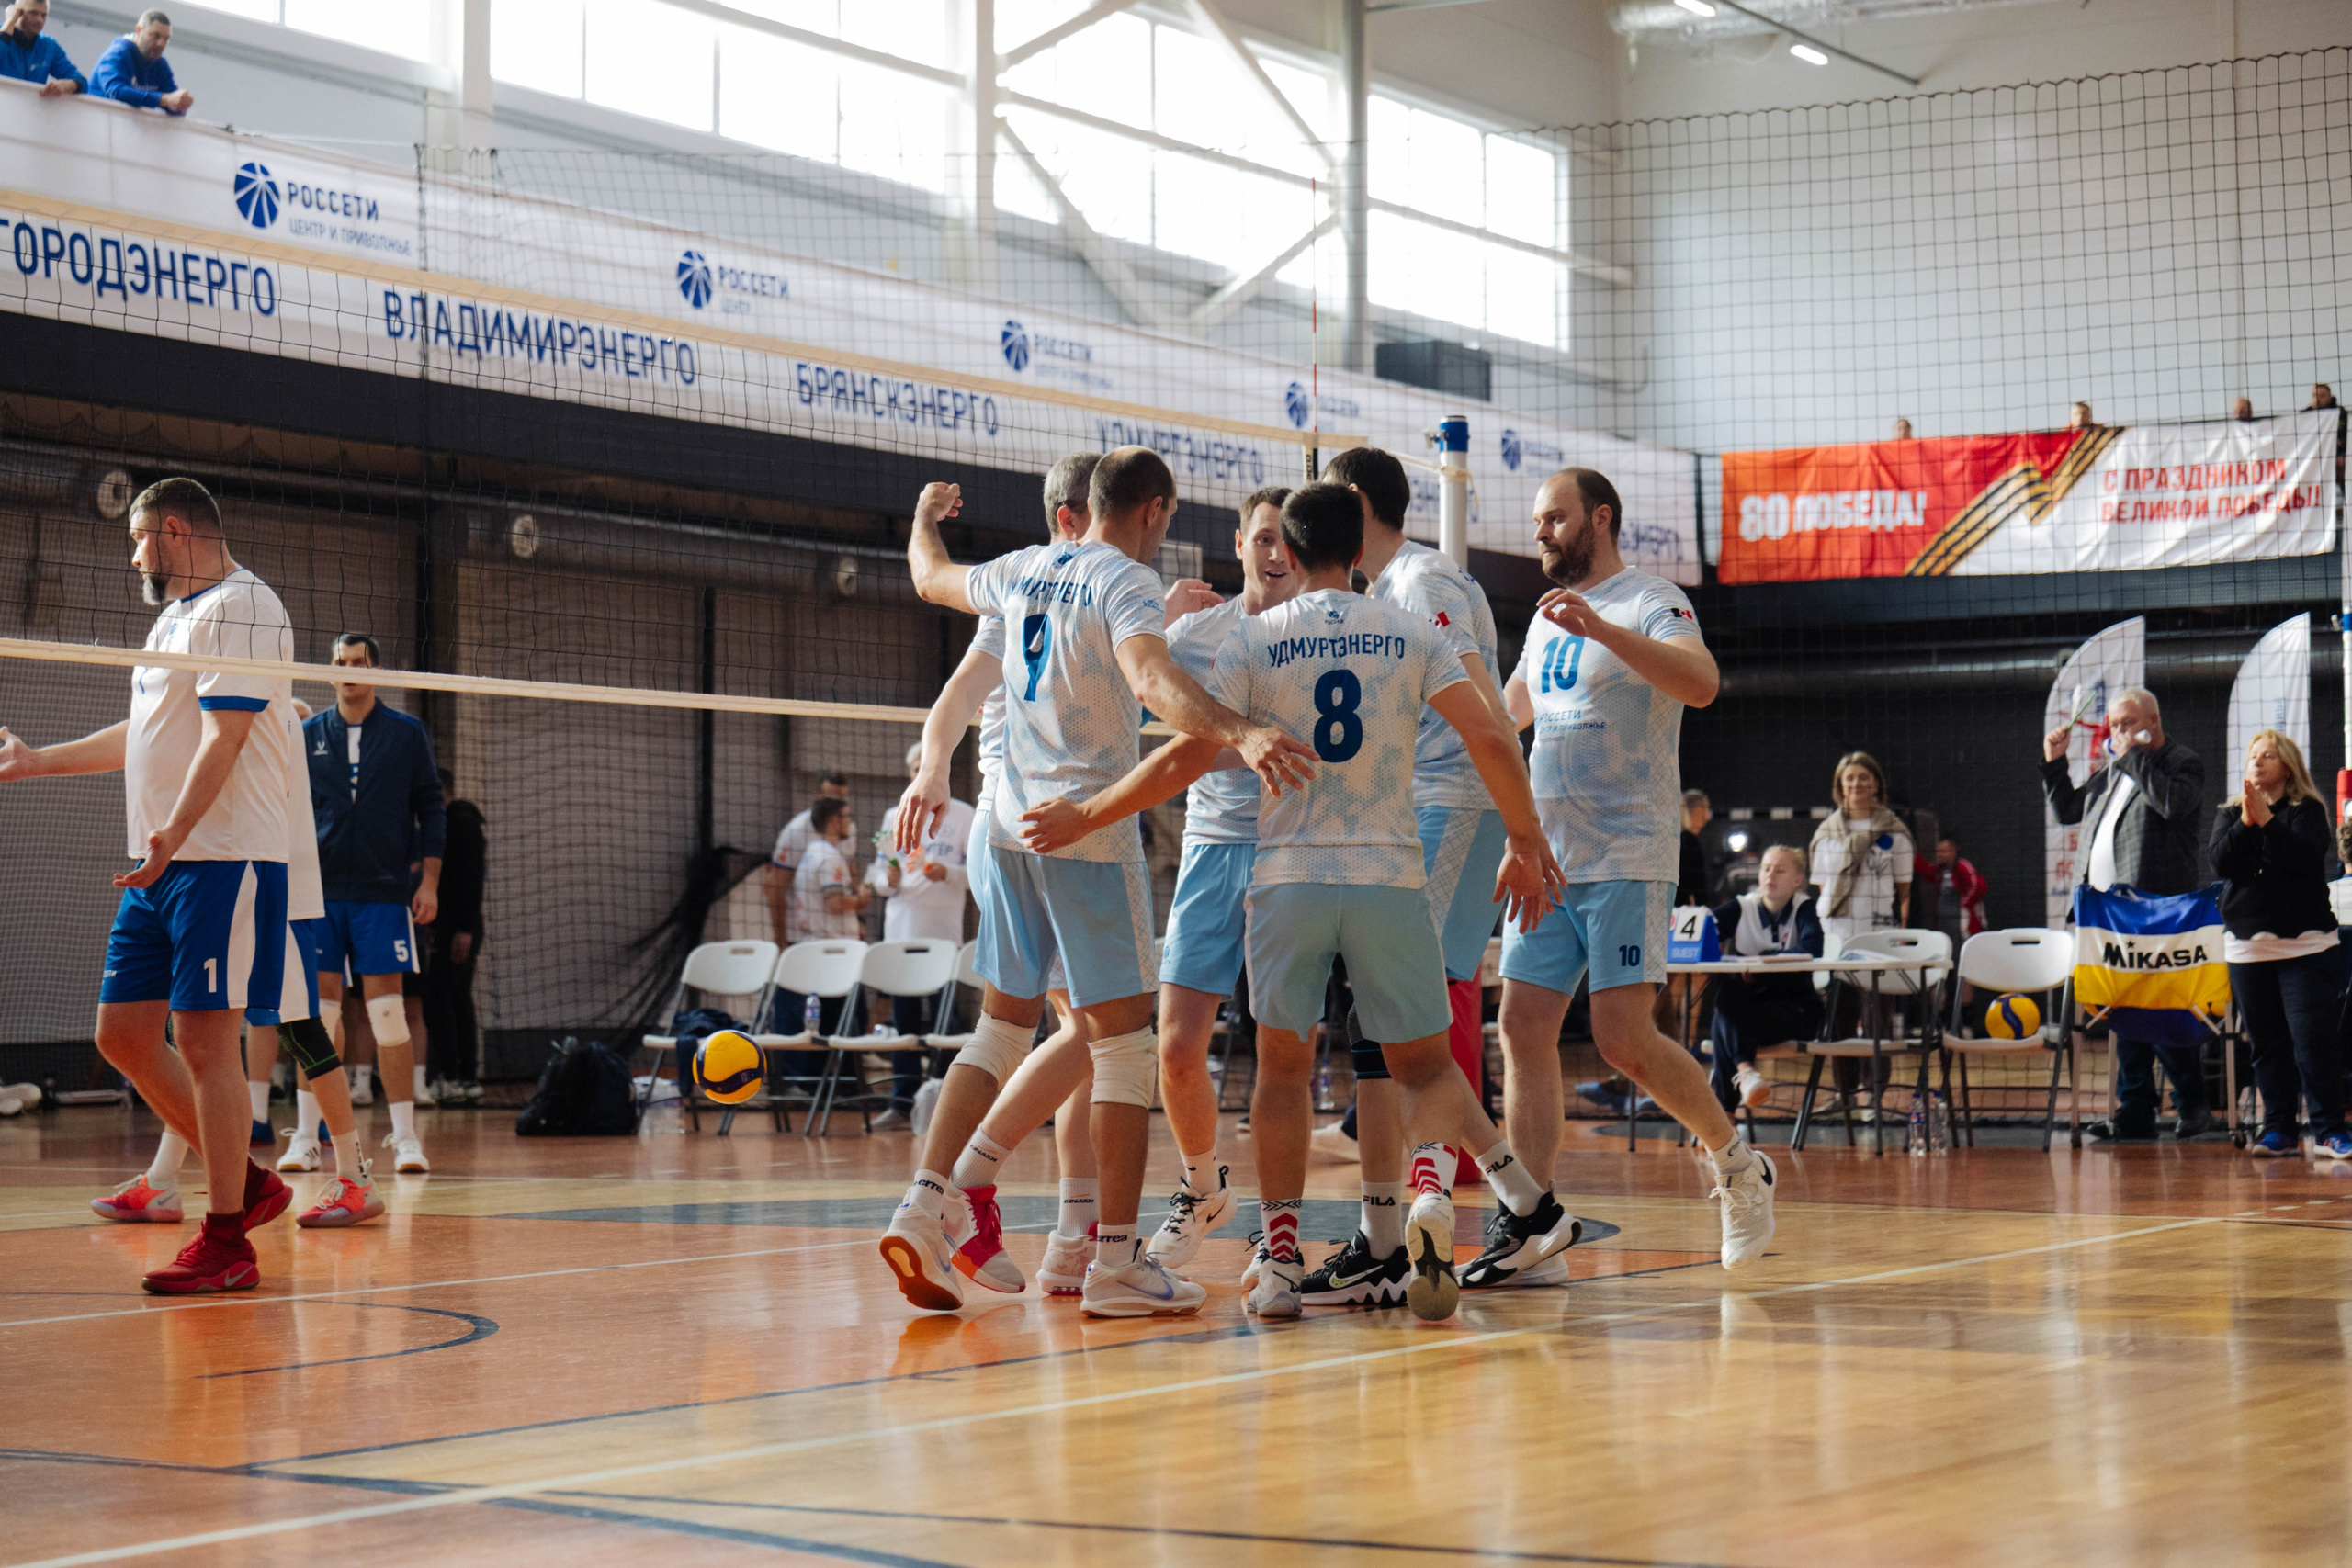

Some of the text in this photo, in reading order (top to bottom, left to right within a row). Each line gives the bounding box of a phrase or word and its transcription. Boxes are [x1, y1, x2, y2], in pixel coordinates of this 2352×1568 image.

[287, 181, 379, 222] РОССЕТИ
[288, 218, 412, 257] ЦЕНТР И ПРИВОЛЖЬЕ
[718, 265, 789, 301] РОССЕТИ
[384, 290, 695, 386] ВЛАДИМИРЭНЕРГО
[796, 363, 999, 436] БРЯНСКЭНЕРГО
[2104, 458, 2286, 492] С ПРАЗДНИКОМ
[1738, 492, 1790, 542] 80
[1794, 488, 1927, 533] ПОБЕДА!
[2101, 484, 2321, 524] ВЕЛИКОЙ ПОБЕДЫ!
[1023, 613, 1053, 702] 9
[1268, 633, 1405, 668] УДМУРТЭНЕРГО
[1541, 634, 1585, 694] 10
[1314, 669, 1363, 763] 8
[1680, 915, 1697, 940] 4
[393, 939, 409, 963] 5
[1618, 944, 1641, 967] 10
[1671, 947, 1701, 959] GUEST
[203, 957, 217, 993] 1
[1485, 1154, 1514, 1176] FILA
[1363, 1195, 1396, 1207] FILA
